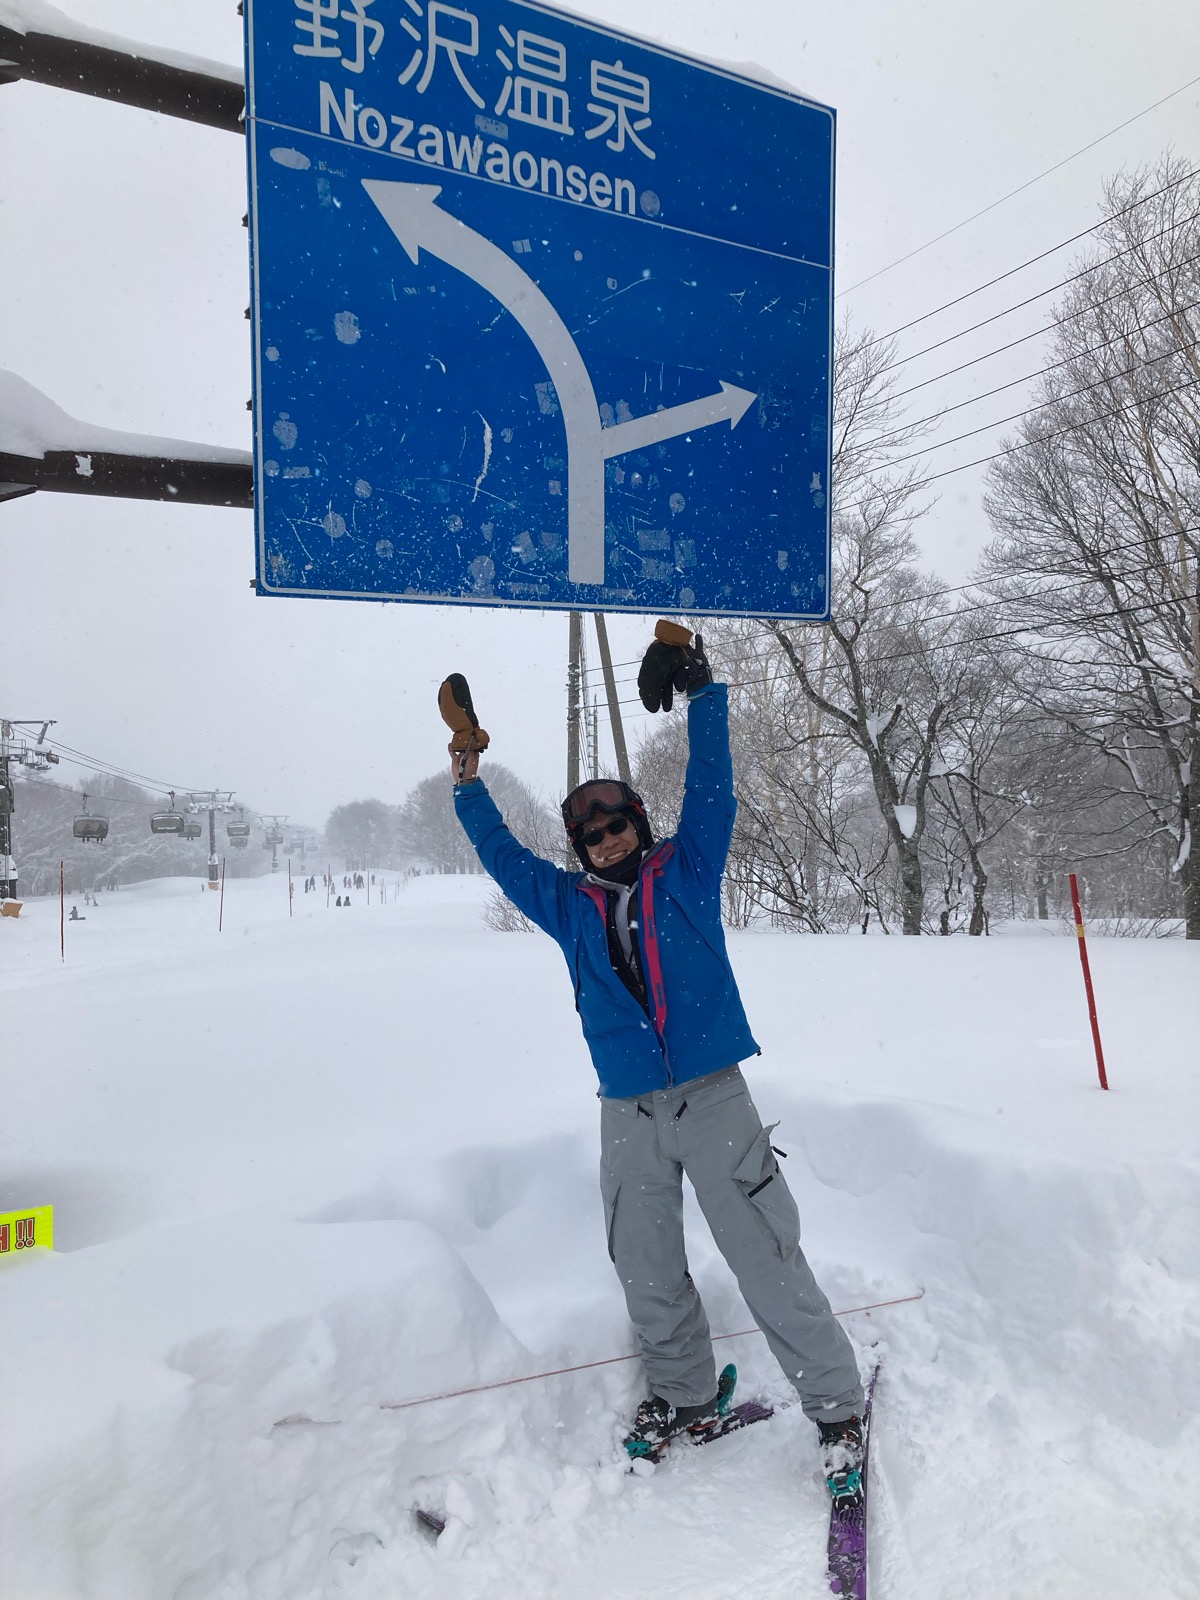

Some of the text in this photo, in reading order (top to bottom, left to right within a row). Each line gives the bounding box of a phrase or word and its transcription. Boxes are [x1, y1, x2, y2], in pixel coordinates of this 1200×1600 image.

[293, 0, 656, 160] 野沢温泉
[319, 80, 636, 215] Nozawaonsen
